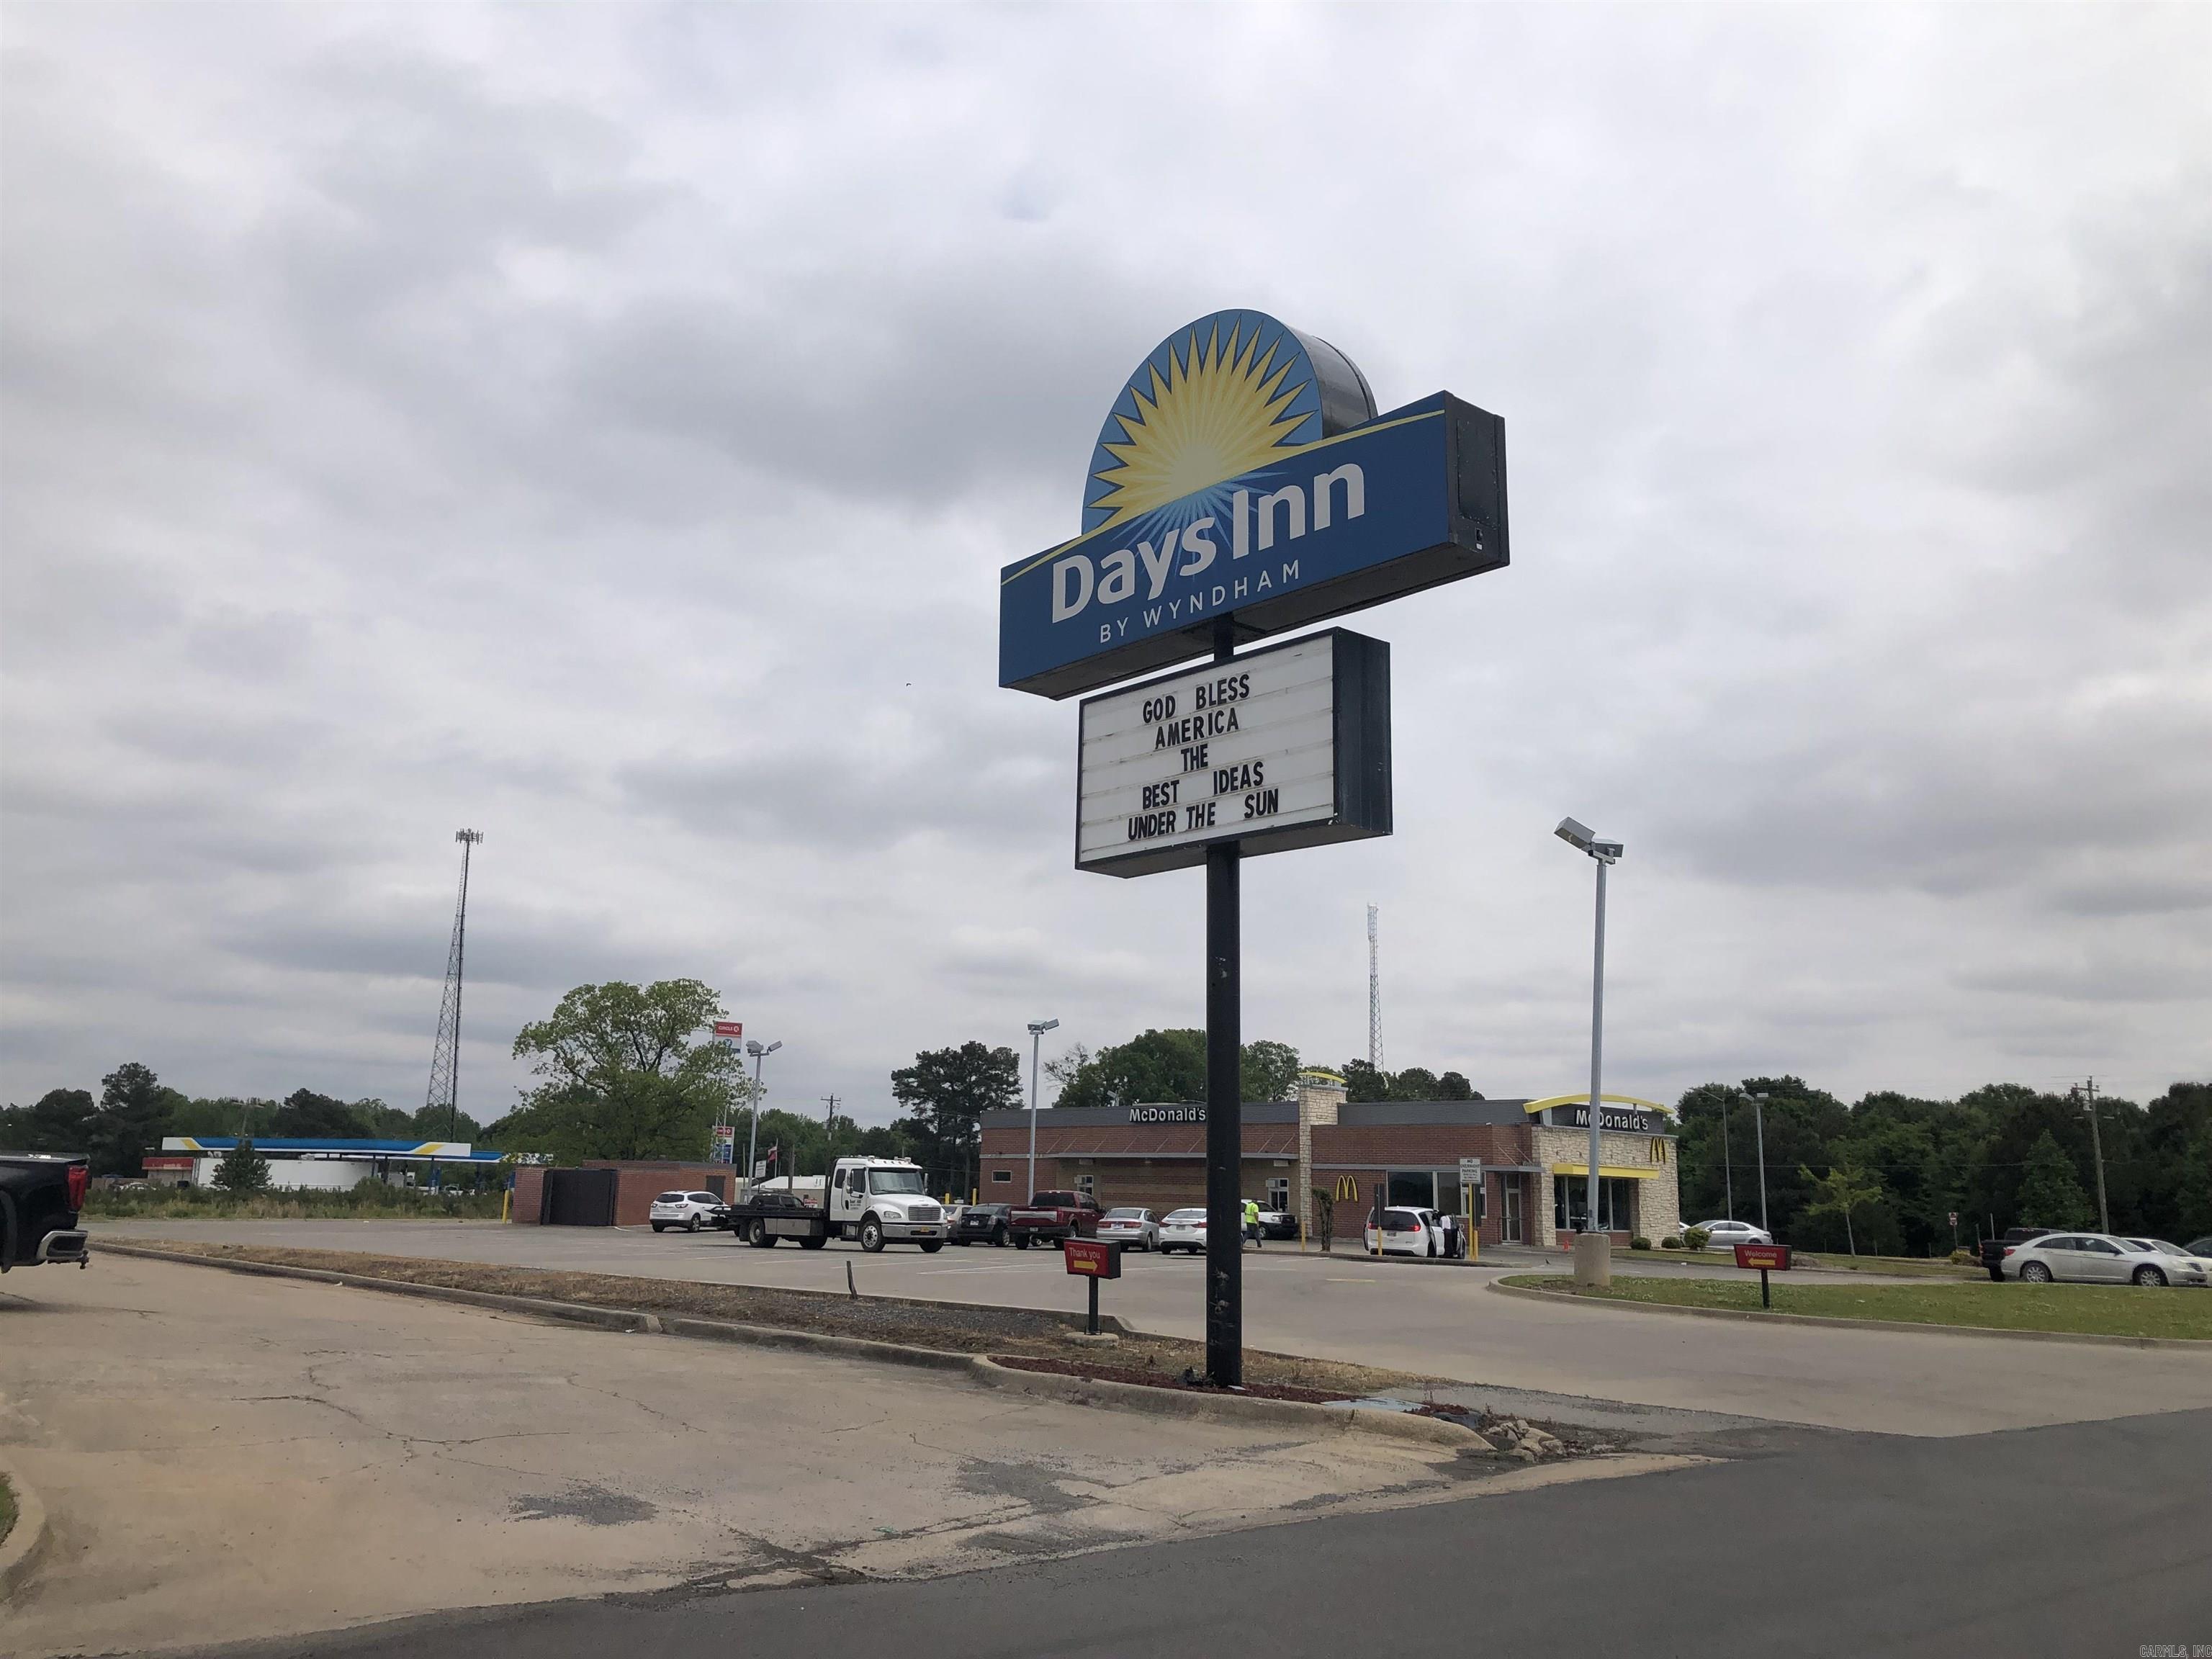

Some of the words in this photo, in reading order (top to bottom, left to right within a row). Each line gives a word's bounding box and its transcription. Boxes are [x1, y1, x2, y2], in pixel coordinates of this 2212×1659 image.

[1052, 516, 1216, 624] Days
[1233, 463, 1364, 559] Inn
[1100, 617, 1129, 643] BY
[1143, 559, 1299, 628] WYNDHAM
[1143, 695, 1176, 724] GOD
[1195, 674, 1249, 710] BLESS
[1155, 707, 1239, 750] AMERICA
[1180, 743, 1208, 772] THE
[1142, 780, 1179, 810] BEST
[1213, 761, 1264, 795] IDEAS
[1128, 810, 1177, 840] UNDER
[1186, 802, 1216, 829] THE
[1244, 788, 1279, 819] SUN
[1129, 1107, 1206, 1122] McDonald's
[1575, 1110, 1648, 1130] MDonald's
[1069, 1247, 1088, 1258] Thank
[1088, 1251, 1101, 1260] you
[1744, 1249, 1777, 1258] Welcome
